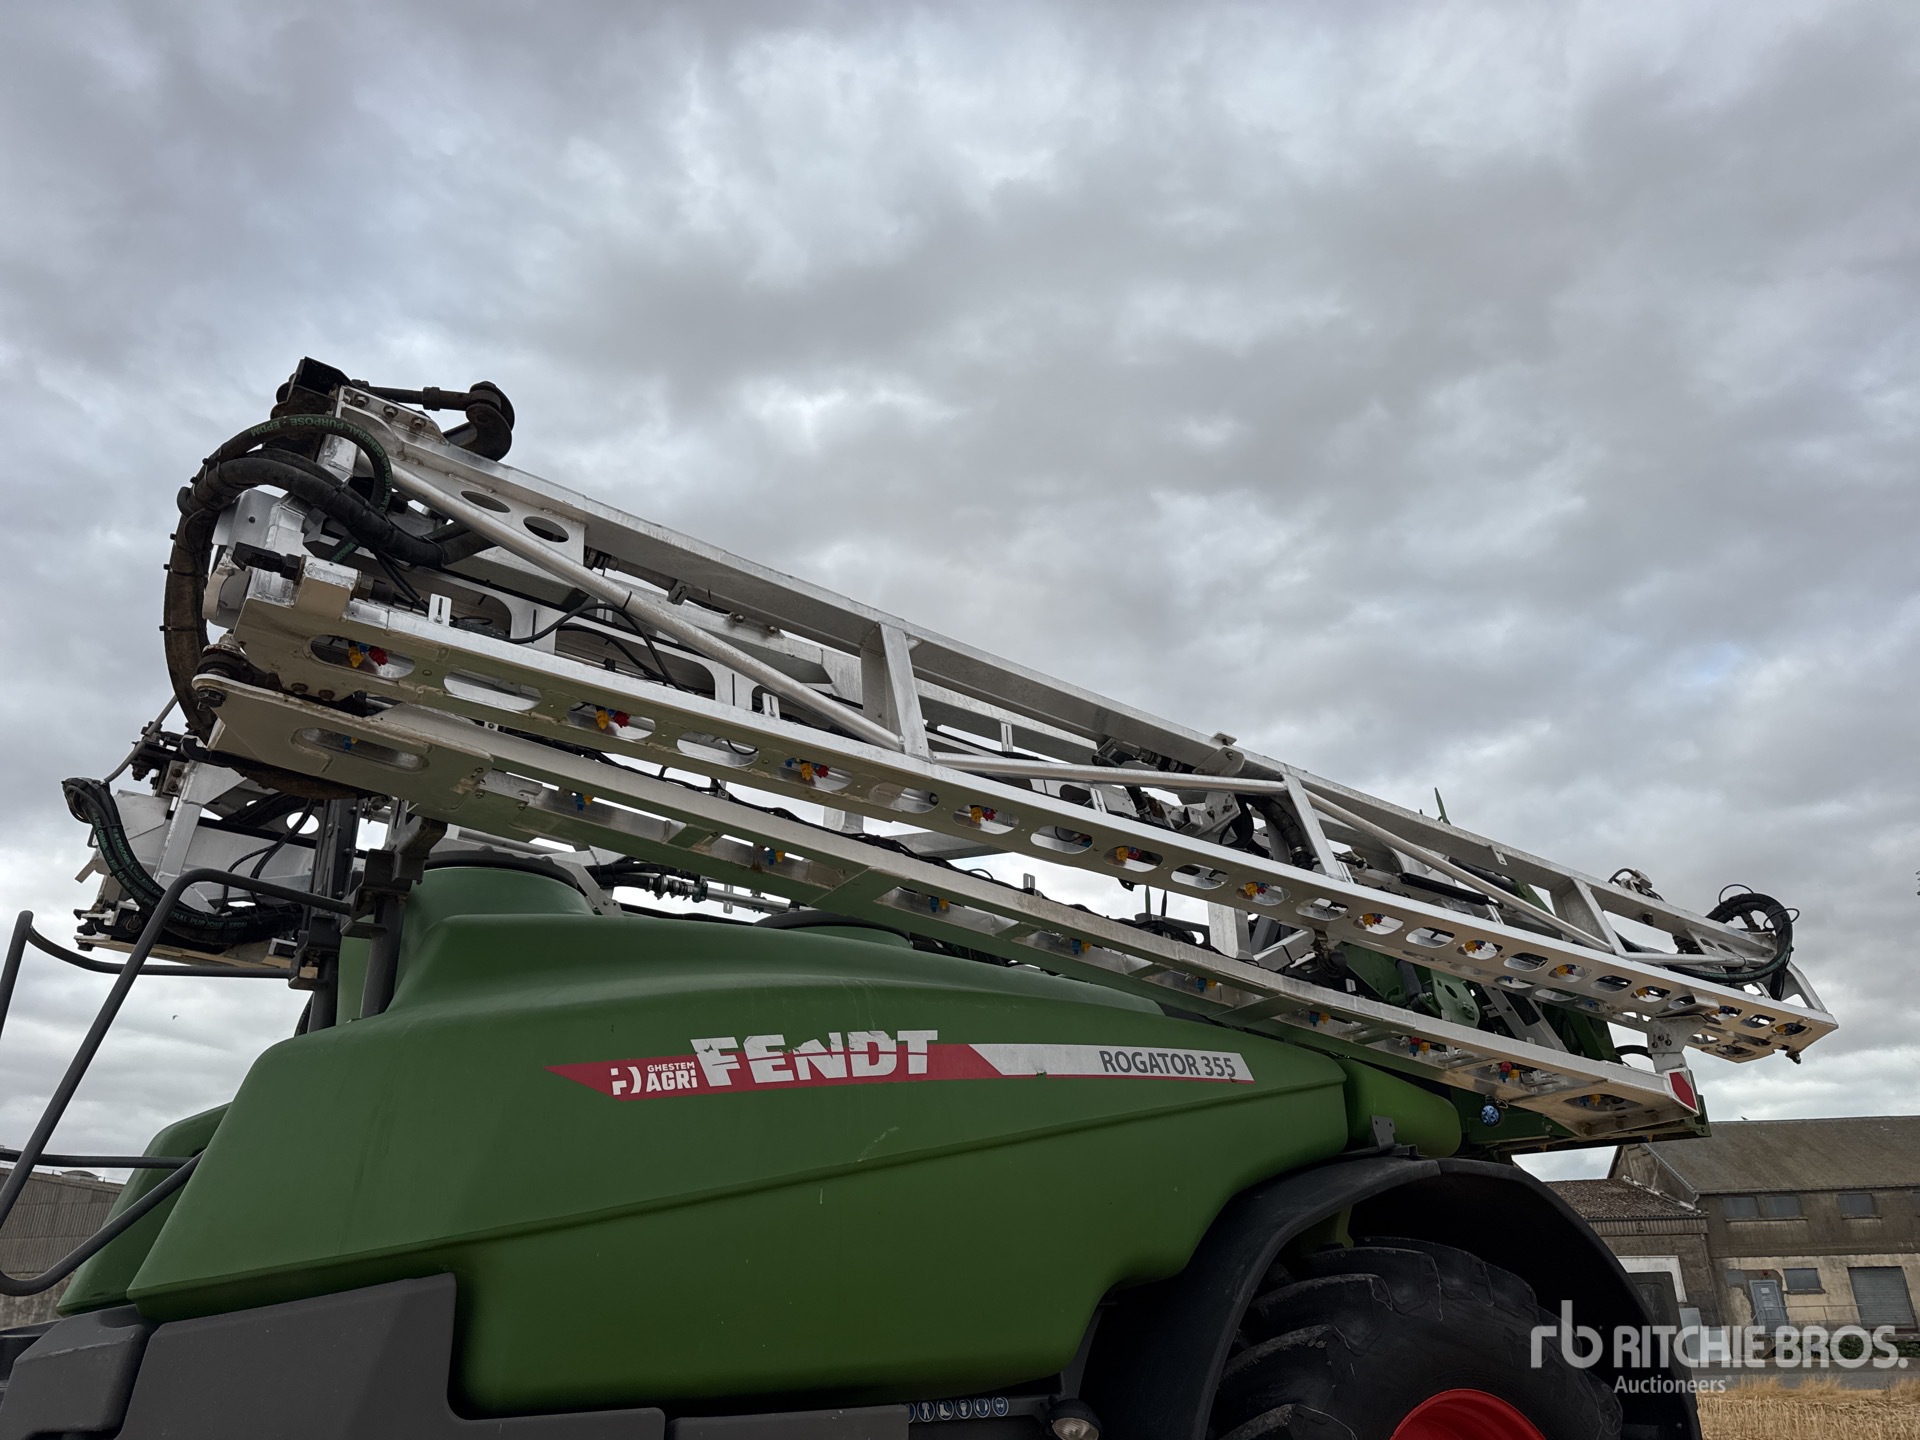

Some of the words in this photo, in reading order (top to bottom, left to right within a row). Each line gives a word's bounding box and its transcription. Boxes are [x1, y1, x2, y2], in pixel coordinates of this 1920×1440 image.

[250, 421, 280, 437] EPDM
[290, 417, 344, 430] PURPOSE
[347, 424, 385, 457] GENERAL
[647, 1061, 695, 1073] GHESTEM
[690, 1030, 938, 1087] FENDT
[1099, 1050, 1201, 1076] ROGATOR
[1200, 1055, 1236, 1078] 355
